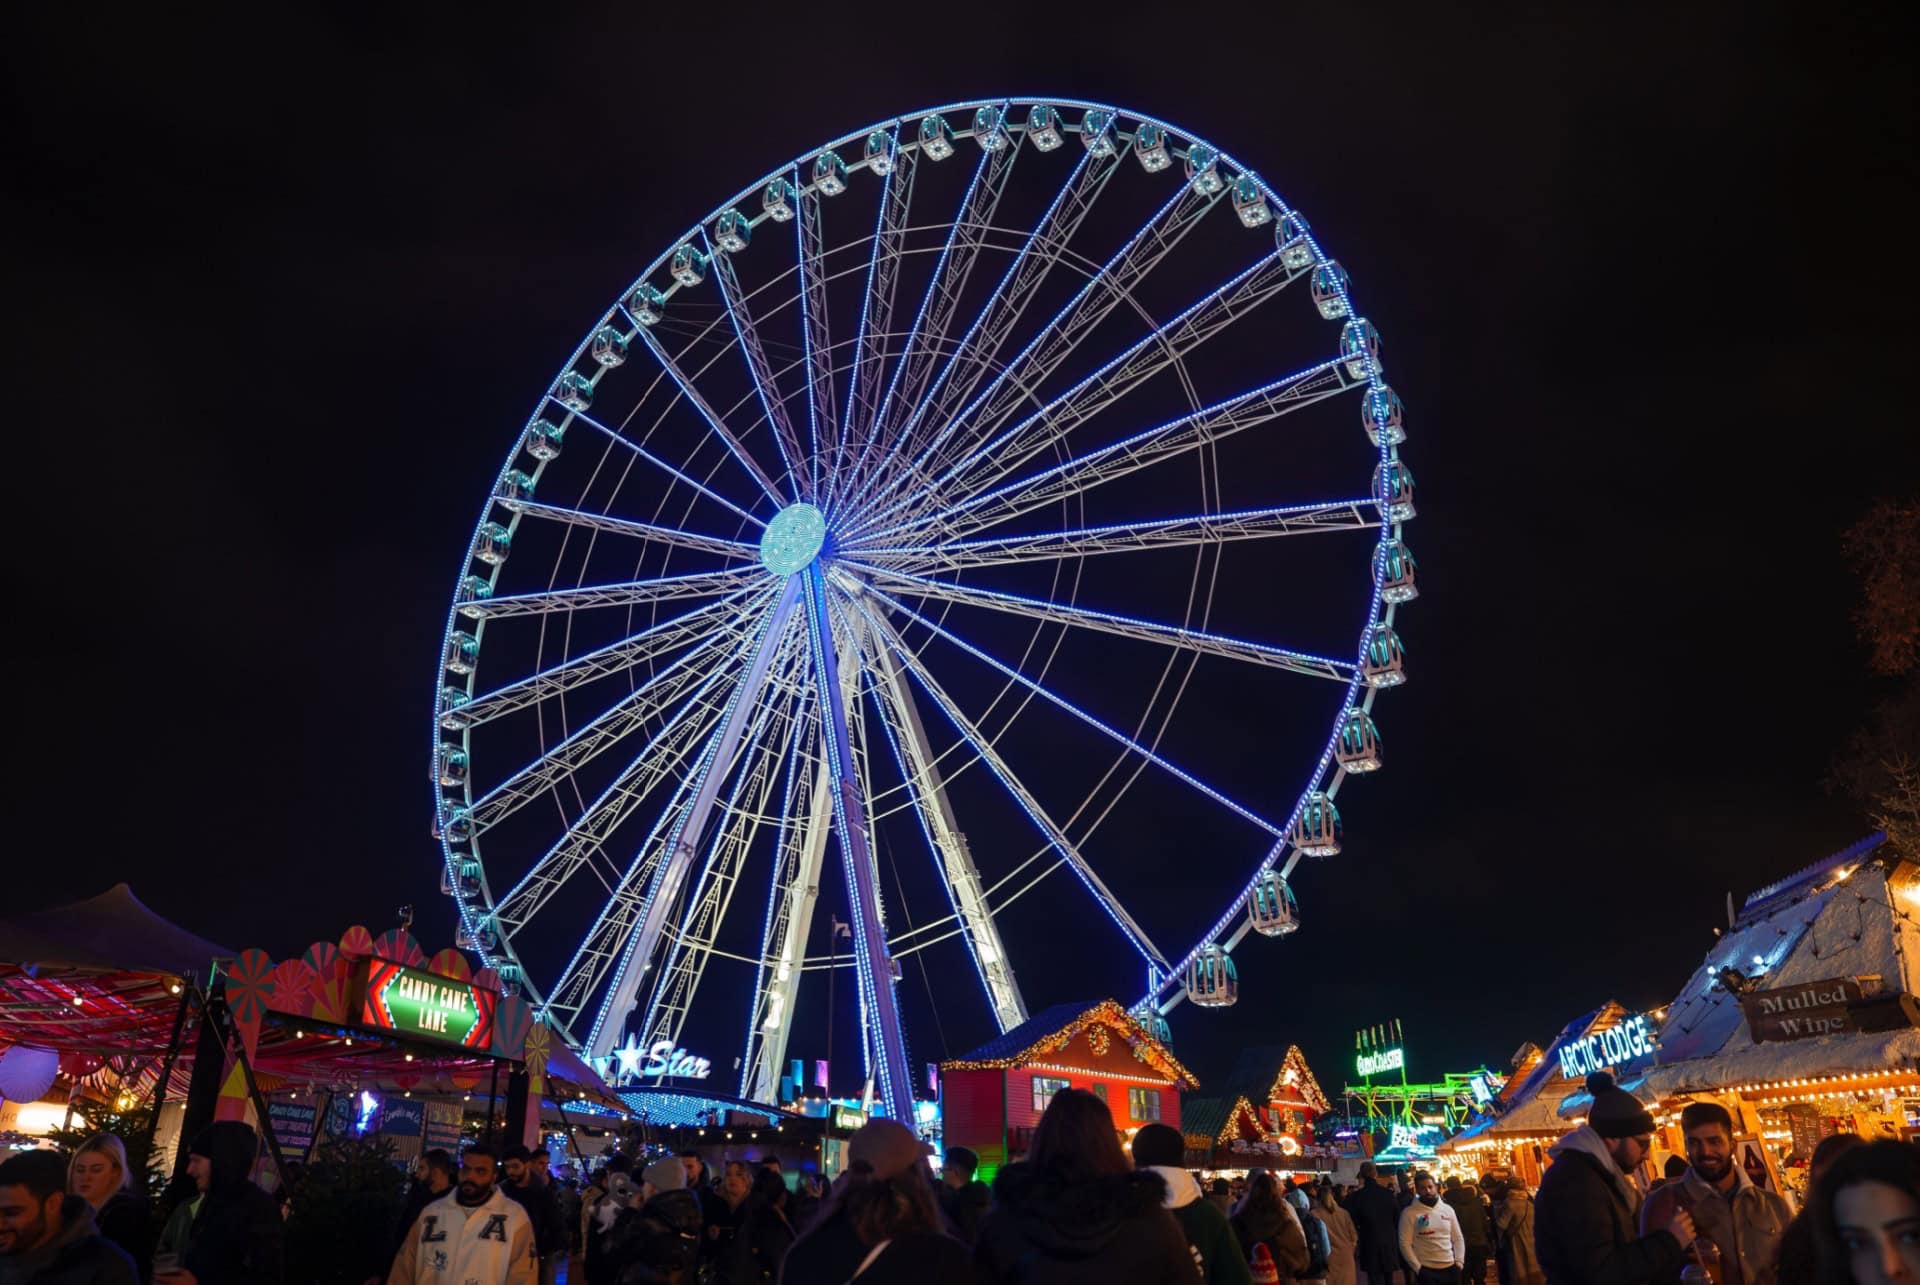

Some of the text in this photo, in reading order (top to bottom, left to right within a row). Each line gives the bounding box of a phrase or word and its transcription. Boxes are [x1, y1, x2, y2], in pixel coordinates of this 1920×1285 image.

[399, 975, 469, 1013] CANDY CANE
[1759, 984, 1849, 1015] Mulled
[418, 1007, 449, 1033] LANE
[1778, 1017, 1844, 1036] Wine
[644, 1040, 711, 1079] Star
[1559, 1015, 1653, 1080] ARCTIC LODGE
[422, 1214, 508, 1243] L A
